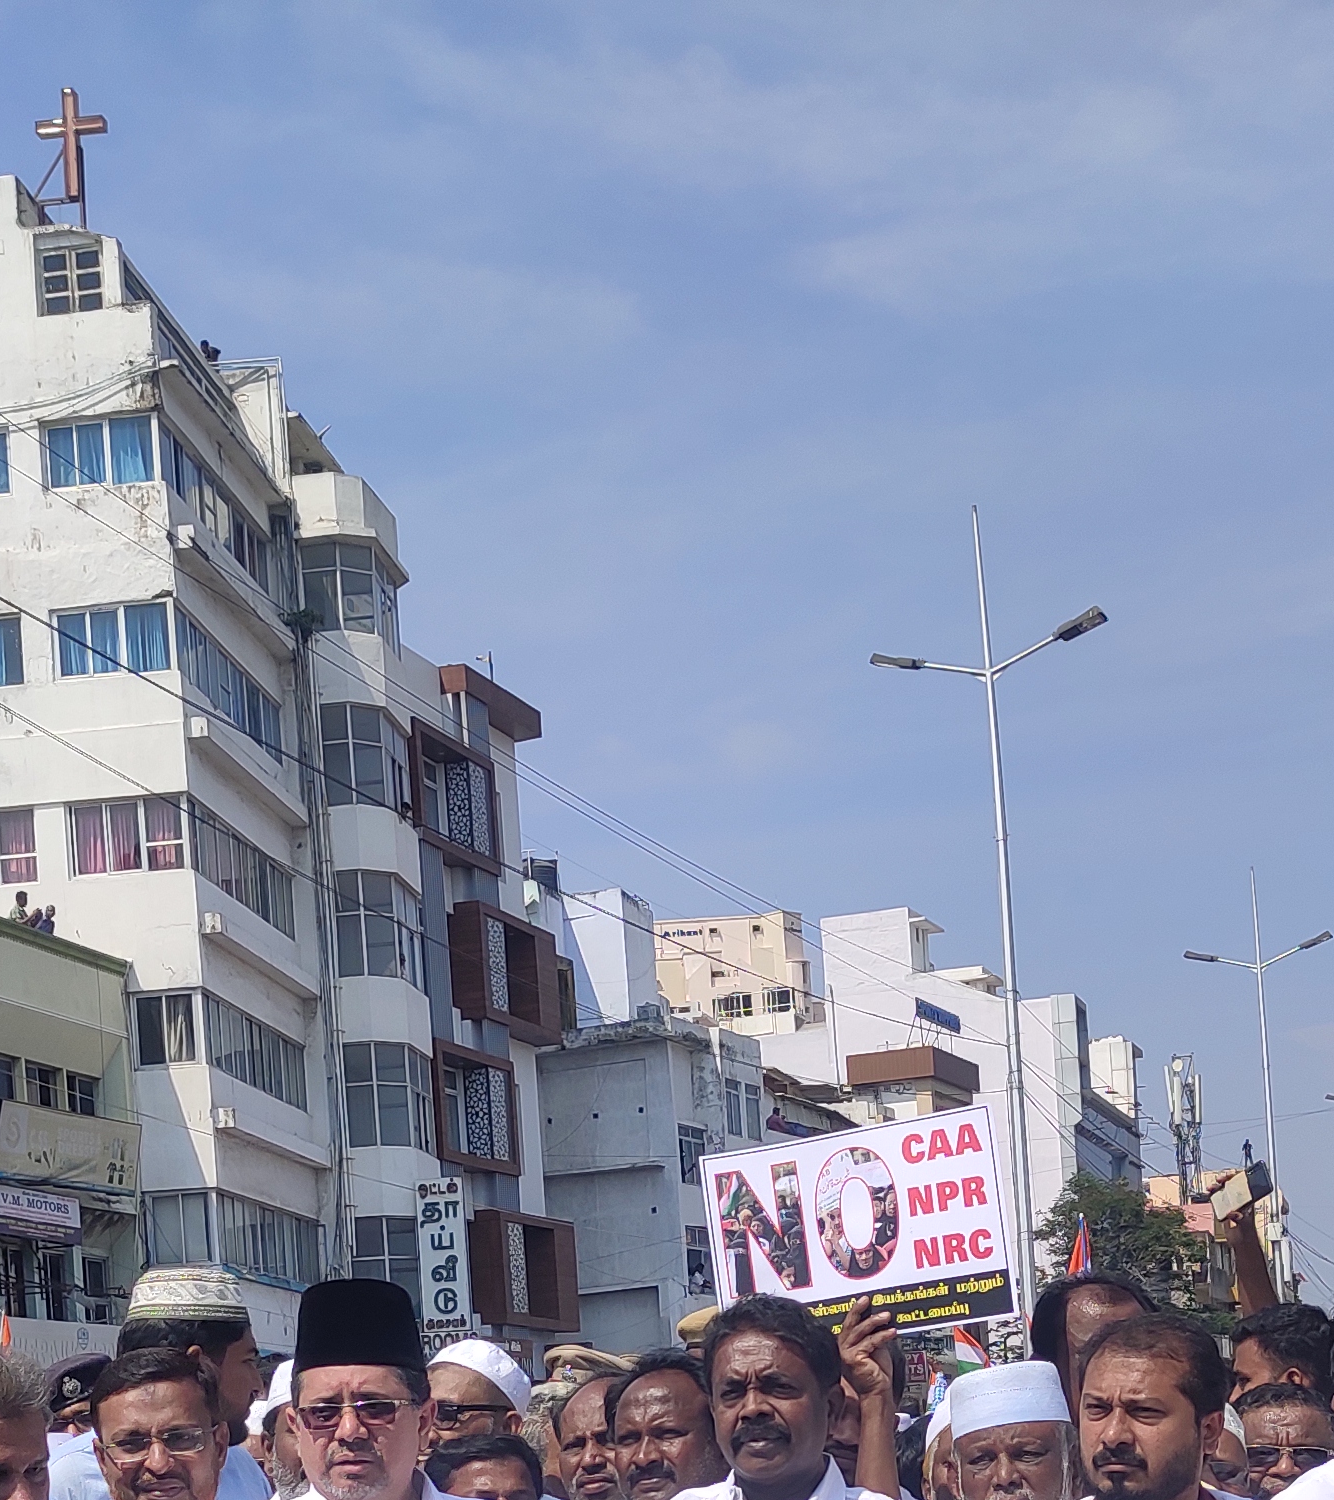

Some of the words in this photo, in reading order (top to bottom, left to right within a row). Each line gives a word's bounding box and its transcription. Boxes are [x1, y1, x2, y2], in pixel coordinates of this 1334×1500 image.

[901, 1122, 983, 1164] CAA
[1, 1192, 23, 1207] V.M.
[27, 1198, 70, 1215] MOTORS
[906, 1175, 988, 1217] NPR
[714, 1146, 899, 1299] NO
[913, 1227, 994, 1270] NRC
[956, 1273, 1005, 1295] மற்றும்
